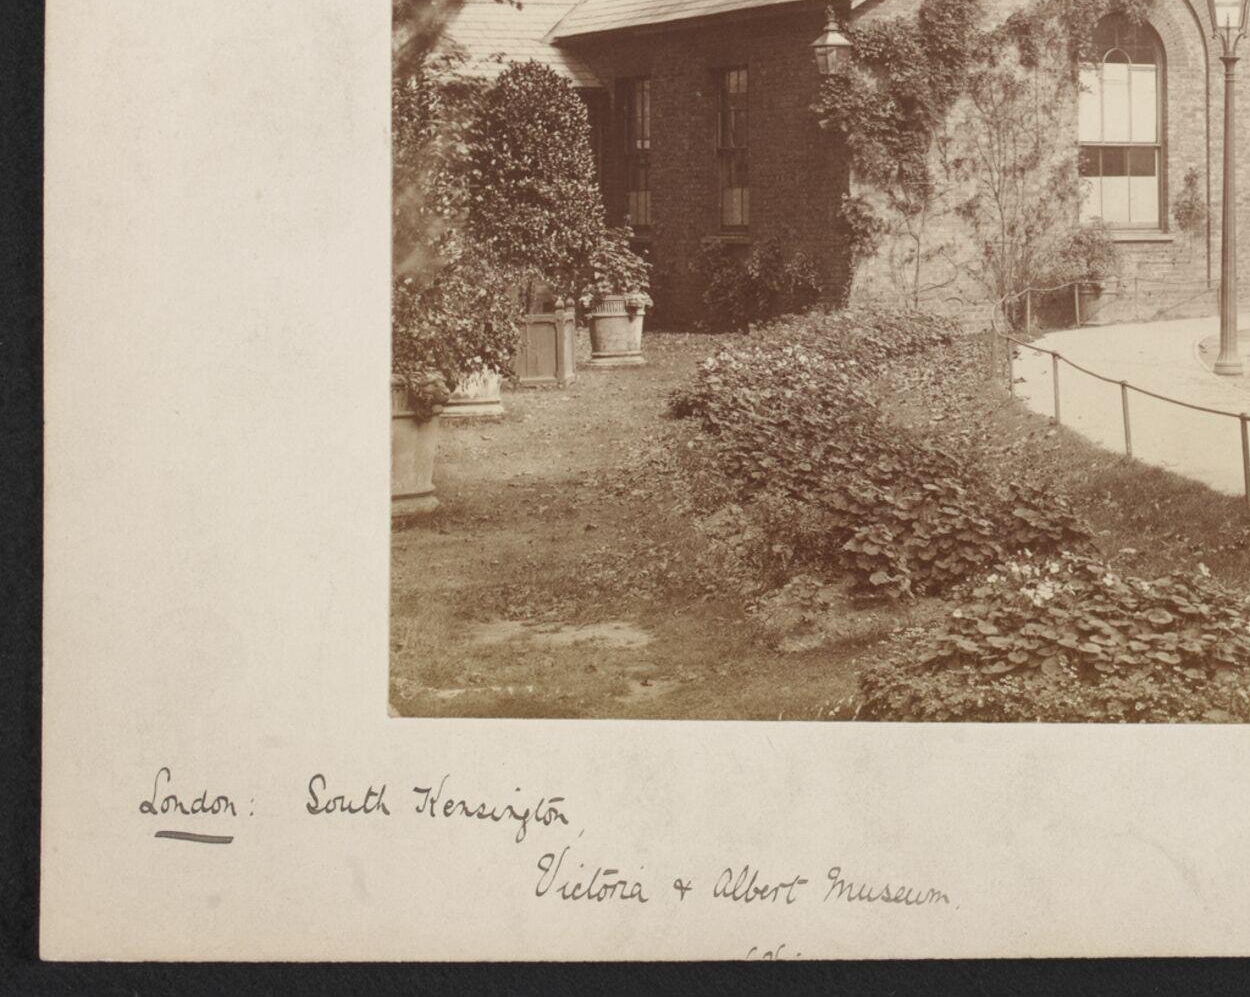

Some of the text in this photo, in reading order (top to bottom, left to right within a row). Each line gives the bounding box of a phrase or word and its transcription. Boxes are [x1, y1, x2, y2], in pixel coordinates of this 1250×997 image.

[139, 766, 255, 818] London:
[305, 773, 391, 817] South
[535, 845, 650, 904] Victoria
[712, 864, 809, 905] Albert
